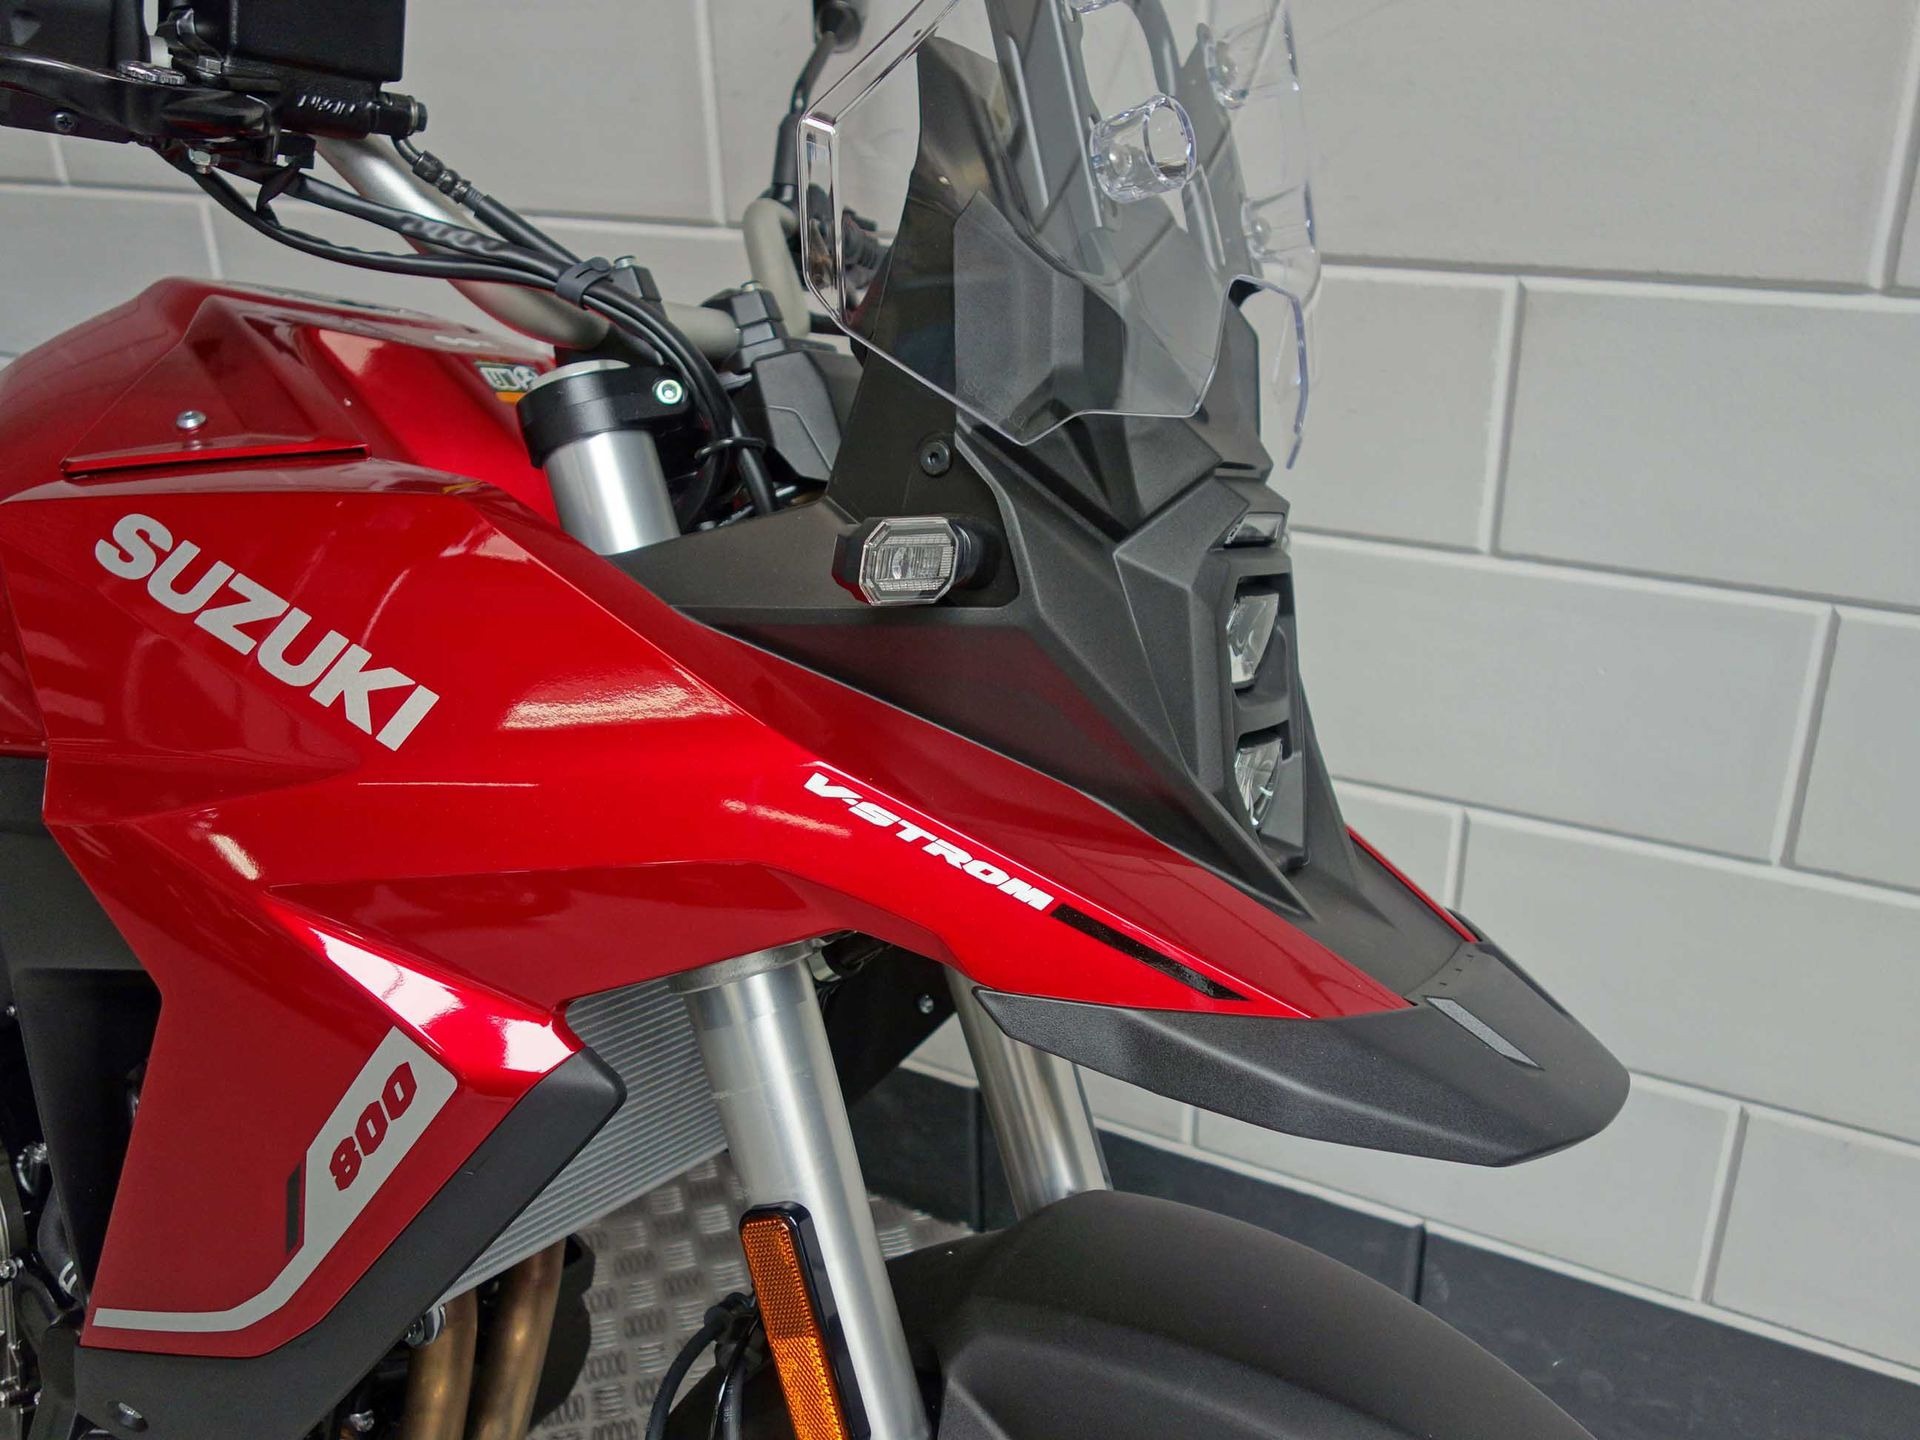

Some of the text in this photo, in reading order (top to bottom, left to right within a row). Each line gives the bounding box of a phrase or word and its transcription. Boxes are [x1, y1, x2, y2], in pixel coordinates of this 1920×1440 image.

[95, 513, 440, 751] SUZUKI
[804, 772, 1054, 911] V-STROM
[329, 1061, 417, 1191] 800
